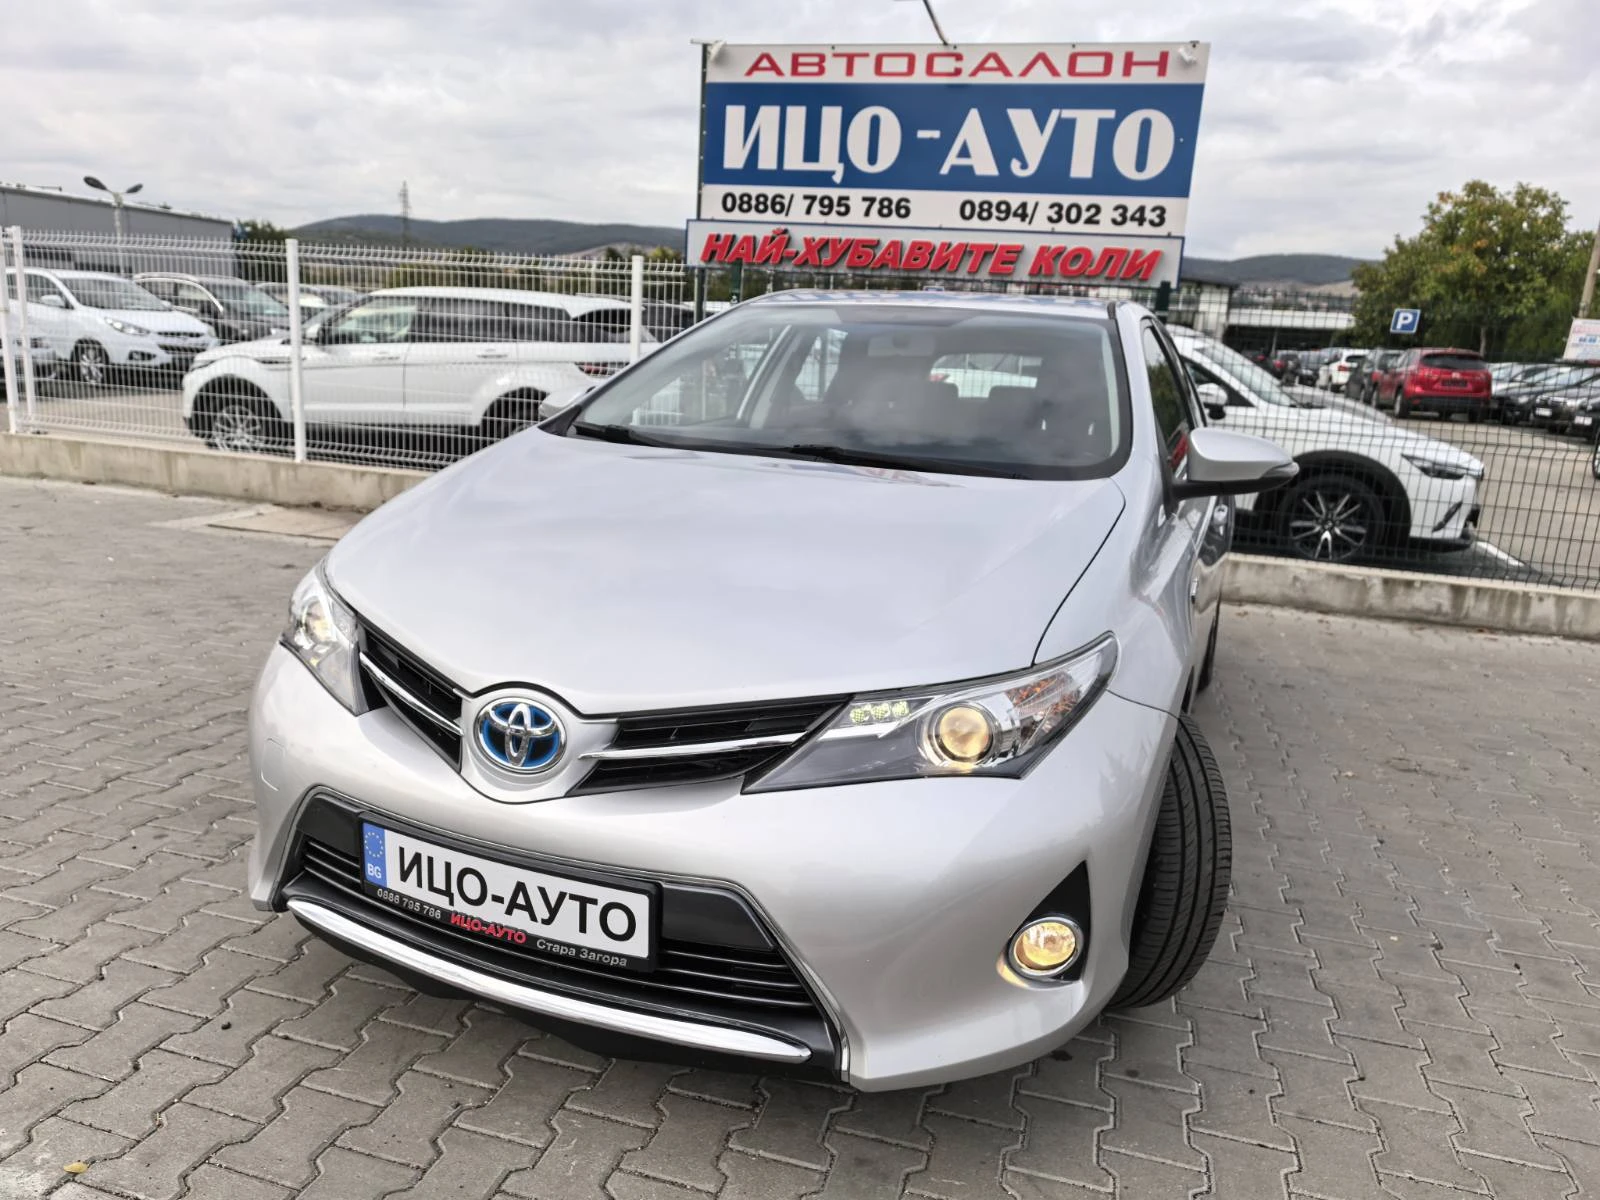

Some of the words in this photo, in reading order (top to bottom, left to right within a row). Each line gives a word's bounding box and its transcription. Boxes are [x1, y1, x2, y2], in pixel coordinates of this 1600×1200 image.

[744, 51, 1170, 77] АВТОСАЛОН
[721, 192, 794, 217] 0886/
[803, 194, 850, 216] 795
[862, 196, 911, 219] 786
[959, 199, 1039, 225] 0894/
[1047, 202, 1101, 225] 302
[1111, 204, 1167, 227] 343
[700, 228, 1024, 276] НАЙ-ХУБАВИТЕ
[1028, 245, 1162, 281] КОЛИ
[1396, 311, 1413, 329] P
[367, 863, 382, 879] BG
[399, 846, 637, 942] ИЦО-АУТО
[376, 888, 401, 904] 0886
[402, 897, 421, 913] 795
[423, 905, 442, 920] 786
[450, 912, 528, 944] ИЦО-АУТО
[536, 939, 576, 957] Стара
[579, 949, 628, 967] Загора
